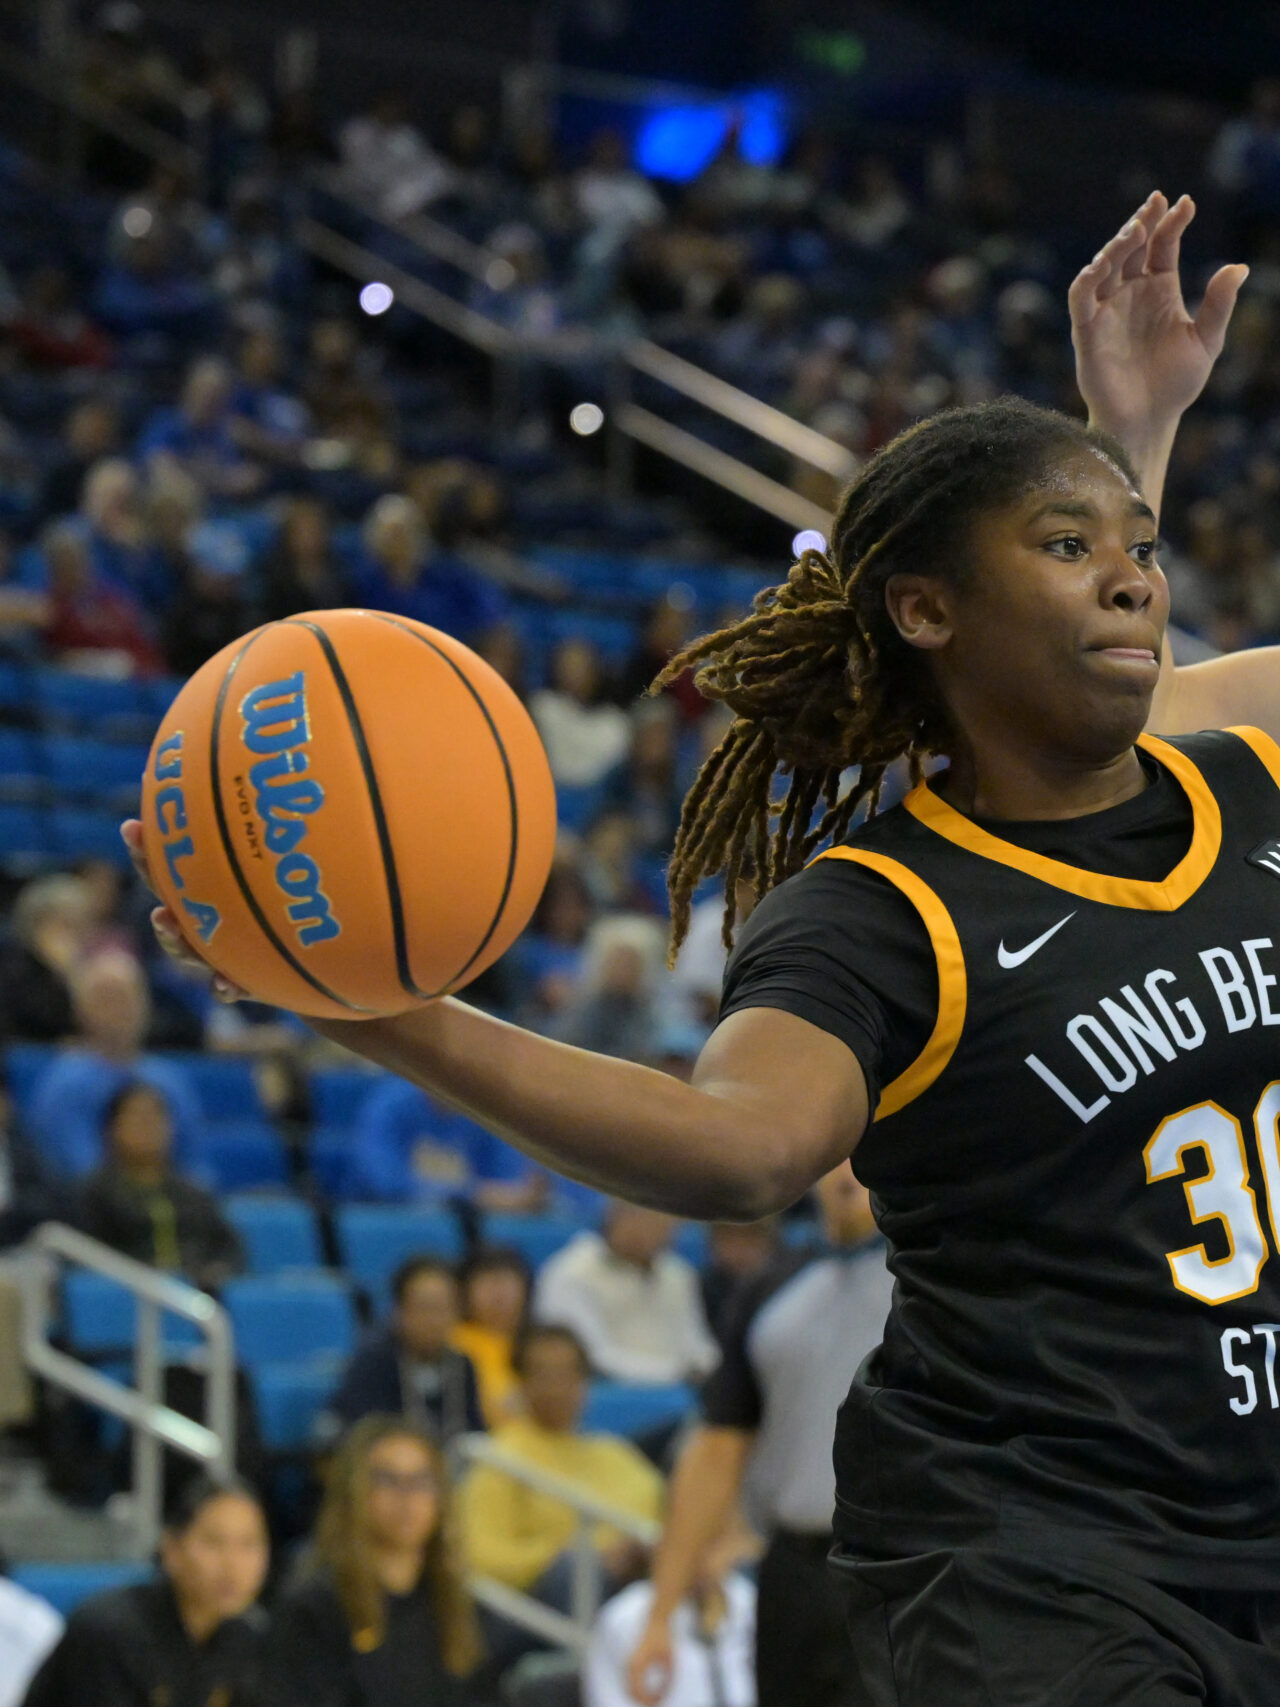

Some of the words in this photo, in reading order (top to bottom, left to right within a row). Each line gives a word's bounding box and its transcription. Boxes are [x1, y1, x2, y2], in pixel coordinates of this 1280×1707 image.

[155, 730, 222, 945] UCLA
[233, 775, 251, 815] EVO
[239, 671, 341, 947] Wilson
[1024, 968, 1207, 1124] LONG
